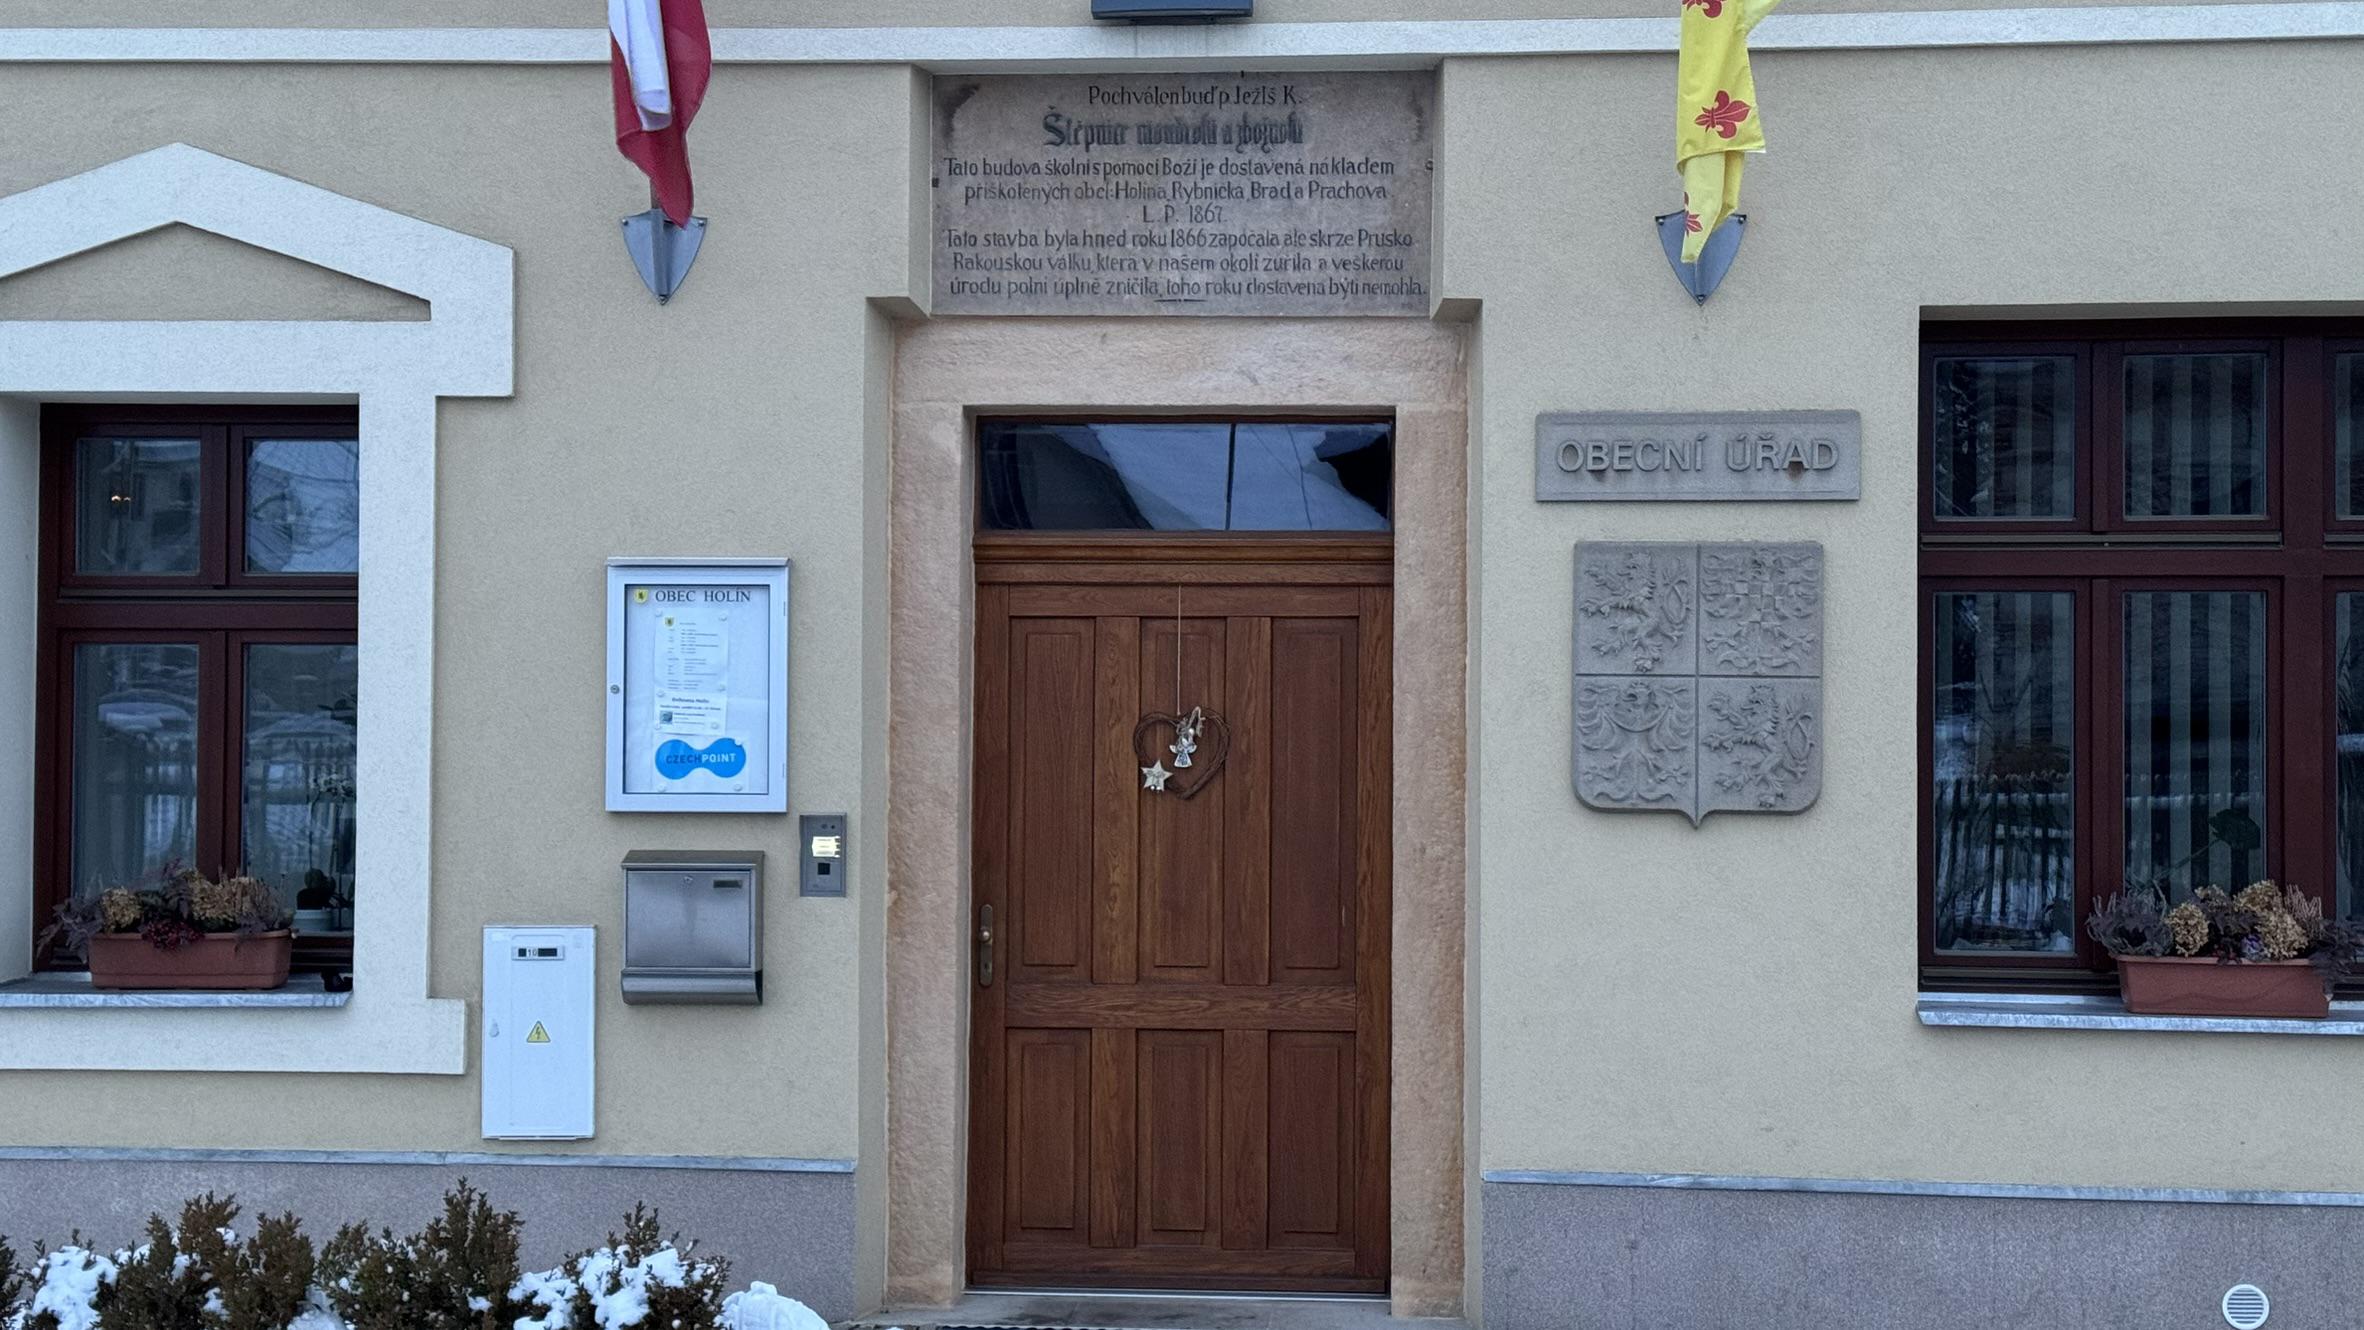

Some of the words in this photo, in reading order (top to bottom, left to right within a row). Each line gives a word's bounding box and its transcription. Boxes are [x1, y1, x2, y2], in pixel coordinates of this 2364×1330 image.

[1181, 85, 1218, 105] buď
[944, 157, 979, 176] Tato
[983, 157, 1041, 176] budova
[1200, 158, 1215, 181] je
[1250, 180, 1291, 200] Brad
[1294, 186, 1304, 200] a
[943, 229, 978, 248] Tato
[982, 228, 1039, 248] stavba
[1045, 228, 1078, 252] byla
[1083, 228, 1126, 248] hned
[1132, 229, 1167, 248] roku
[1170, 228, 1206, 248] 1866
[1284, 229, 1307, 248] ale
[1309, 228, 1354, 248] skrze
[953, 251, 1043, 271] Rakouskou
[1142, 257, 1154, 272] v
[1158, 254, 1215, 272] našem
[1318, 257, 1327, 272] a
[950, 276, 1001, 295] úrodu
[1166, 276, 1201, 295] toho
[1205, 276, 1242, 295] roku
[1362, 276, 1427, 296] nemohla.
[1555, 434, 1708, 474] OBECNÍ
[1724, 431, 1840, 474] ÚŘAD
[655, 589, 697, 603] OBEC
[701, 752, 737, 764] POINT
